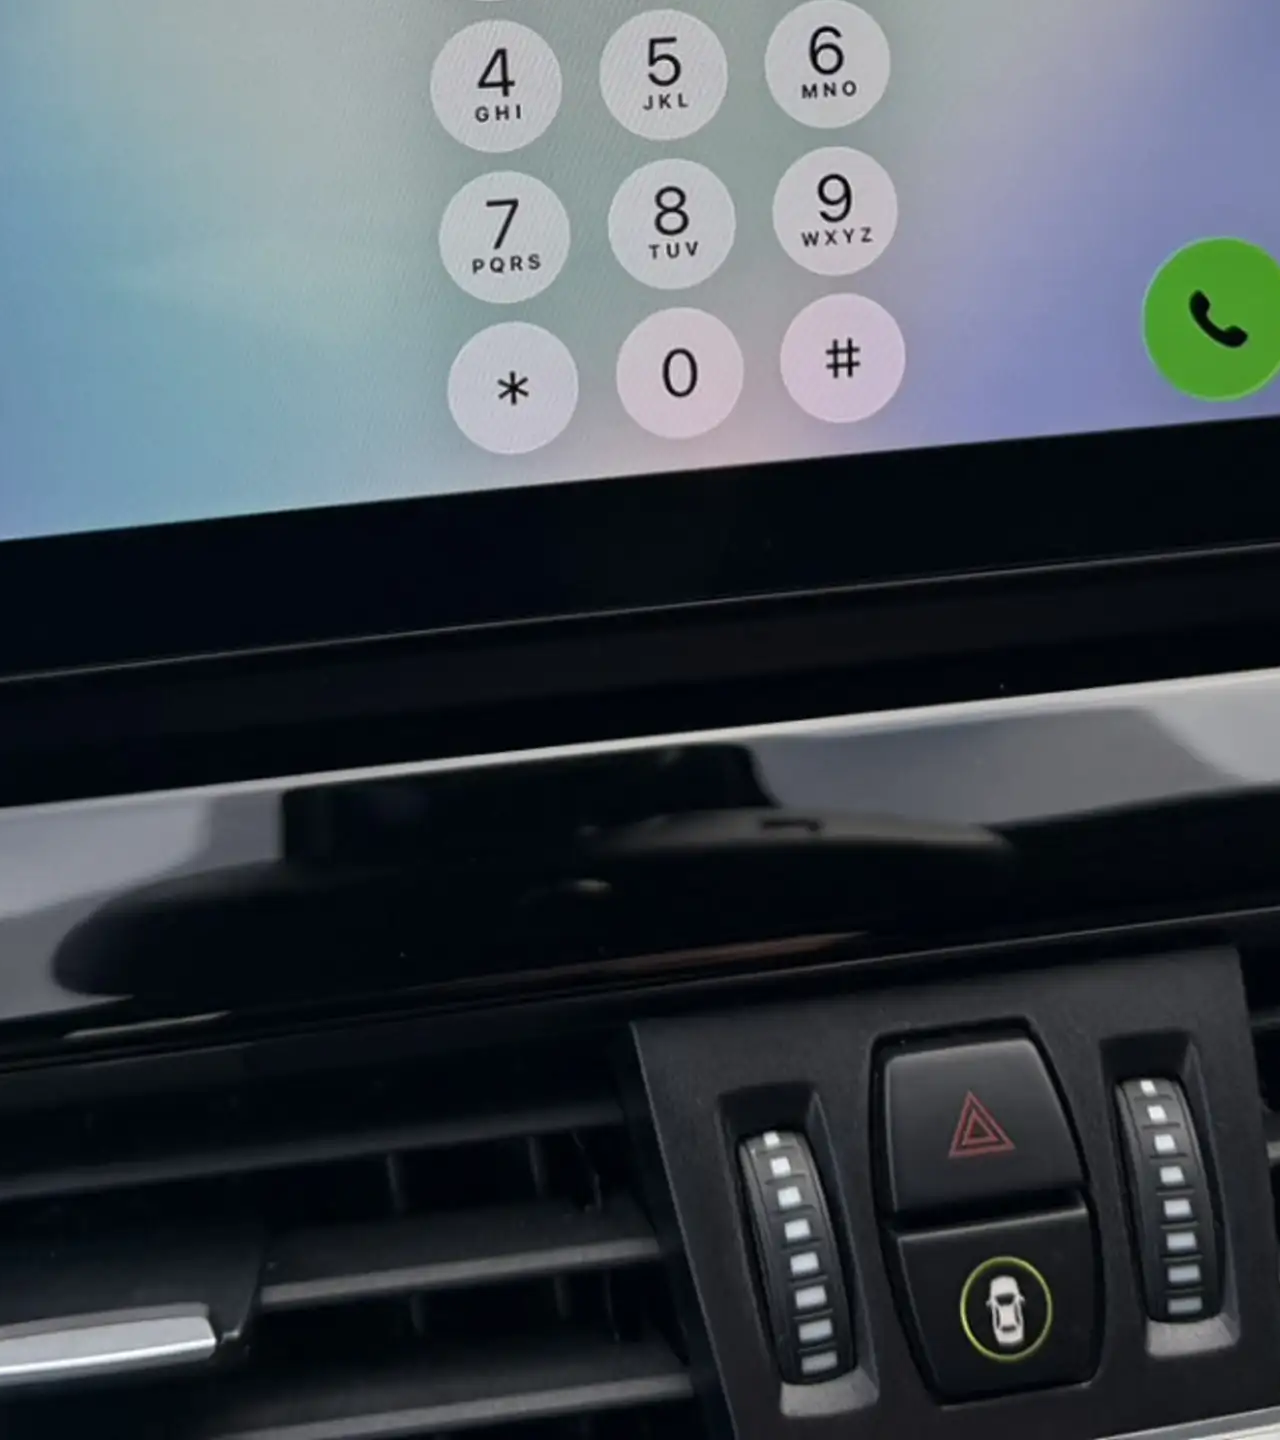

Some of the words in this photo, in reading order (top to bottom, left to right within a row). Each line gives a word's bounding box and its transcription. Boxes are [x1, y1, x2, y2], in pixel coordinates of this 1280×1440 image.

[477, 48, 516, 97] 4
[648, 36, 681, 87] 5
[809, 25, 844, 76] 6
[643, 93, 688, 111] JKL
[801, 80, 857, 99] MNO
[474, 104, 521, 123] GHI
[654, 186, 689, 236] 8
[817, 173, 852, 223] 9
[485, 198, 519, 250] 7
[801, 227, 872, 247] WXYZ
[472, 254, 541, 274] PQRS
[648, 241, 699, 259] TUV
[662, 348, 698, 398] 0
[825, 337, 861, 379] #
